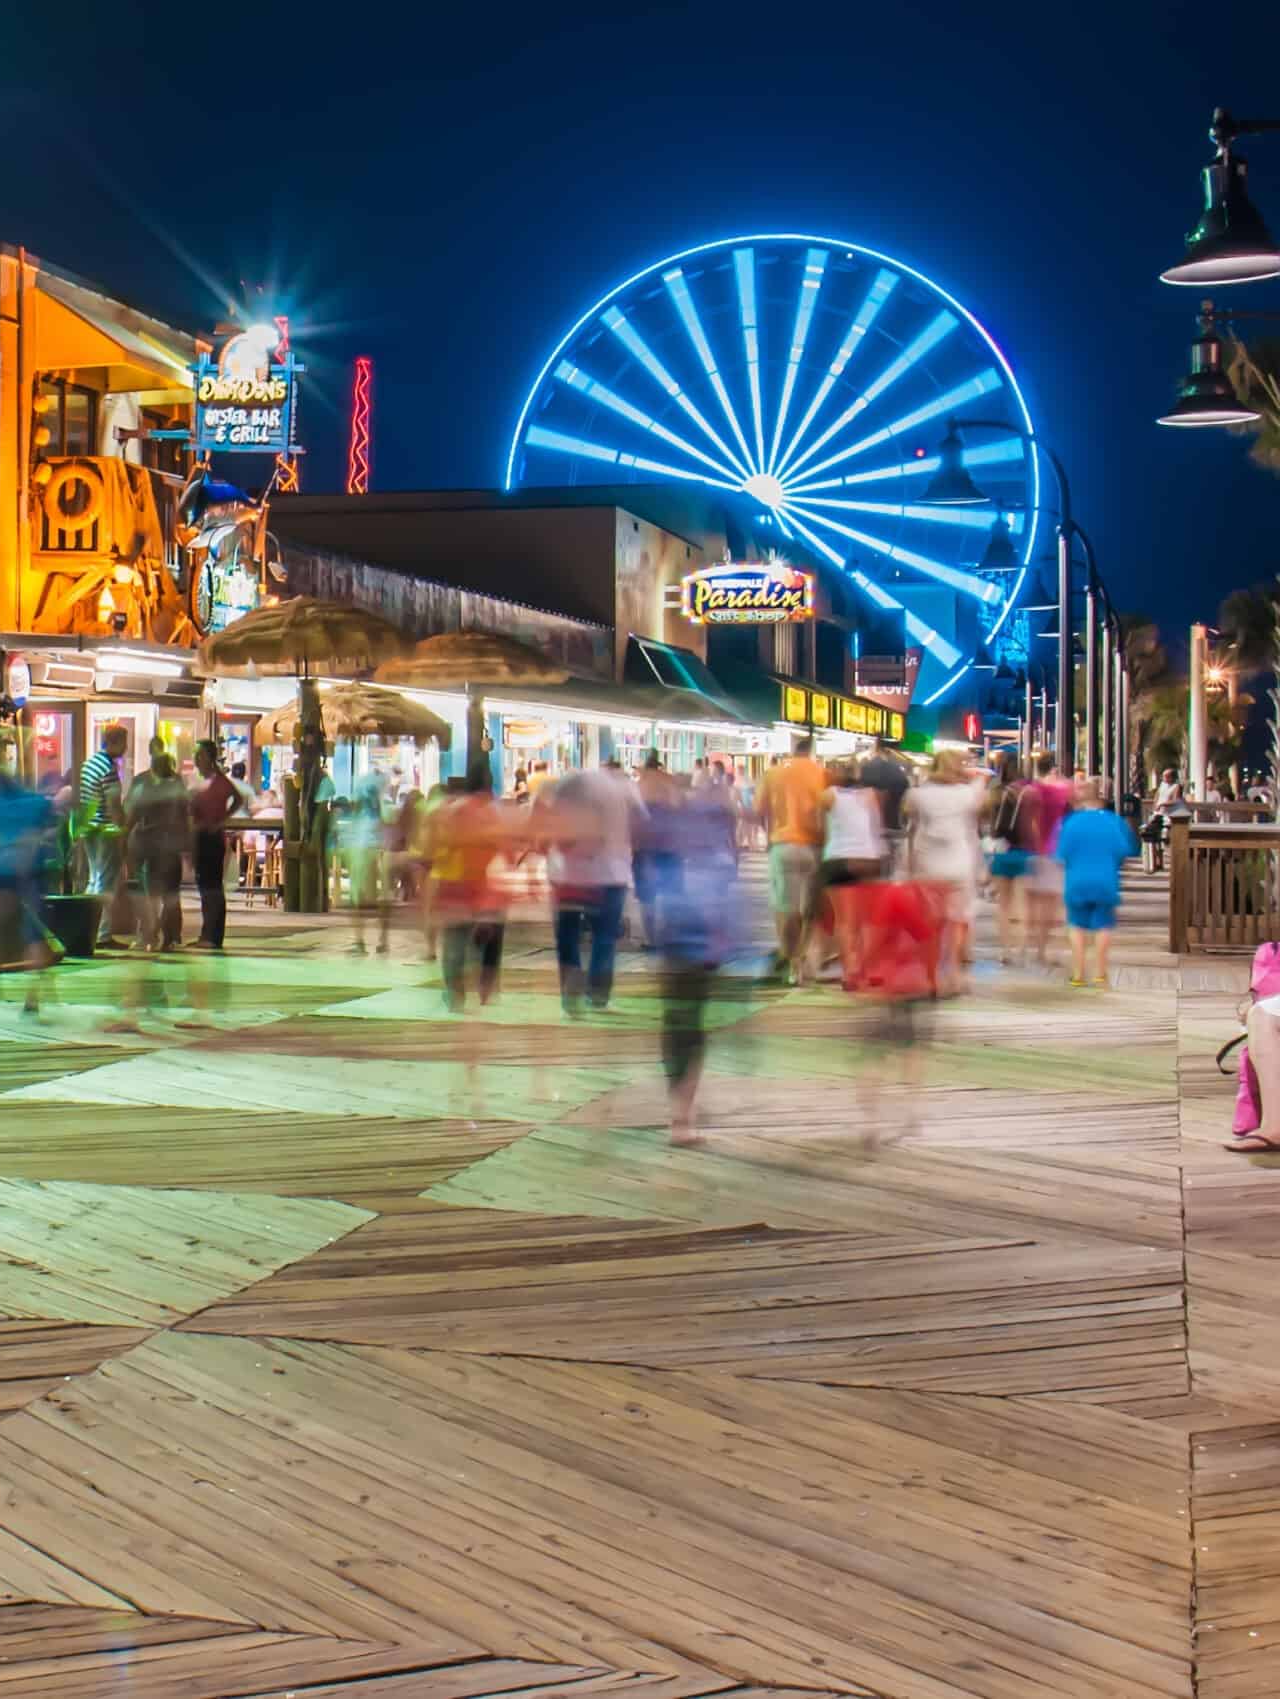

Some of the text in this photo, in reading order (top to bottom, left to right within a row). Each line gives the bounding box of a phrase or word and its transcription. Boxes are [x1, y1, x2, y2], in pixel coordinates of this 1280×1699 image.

[251, 408, 281, 429] BAR
[229, 426, 270, 444] GRILL
[694, 573, 802, 617] Paradise
